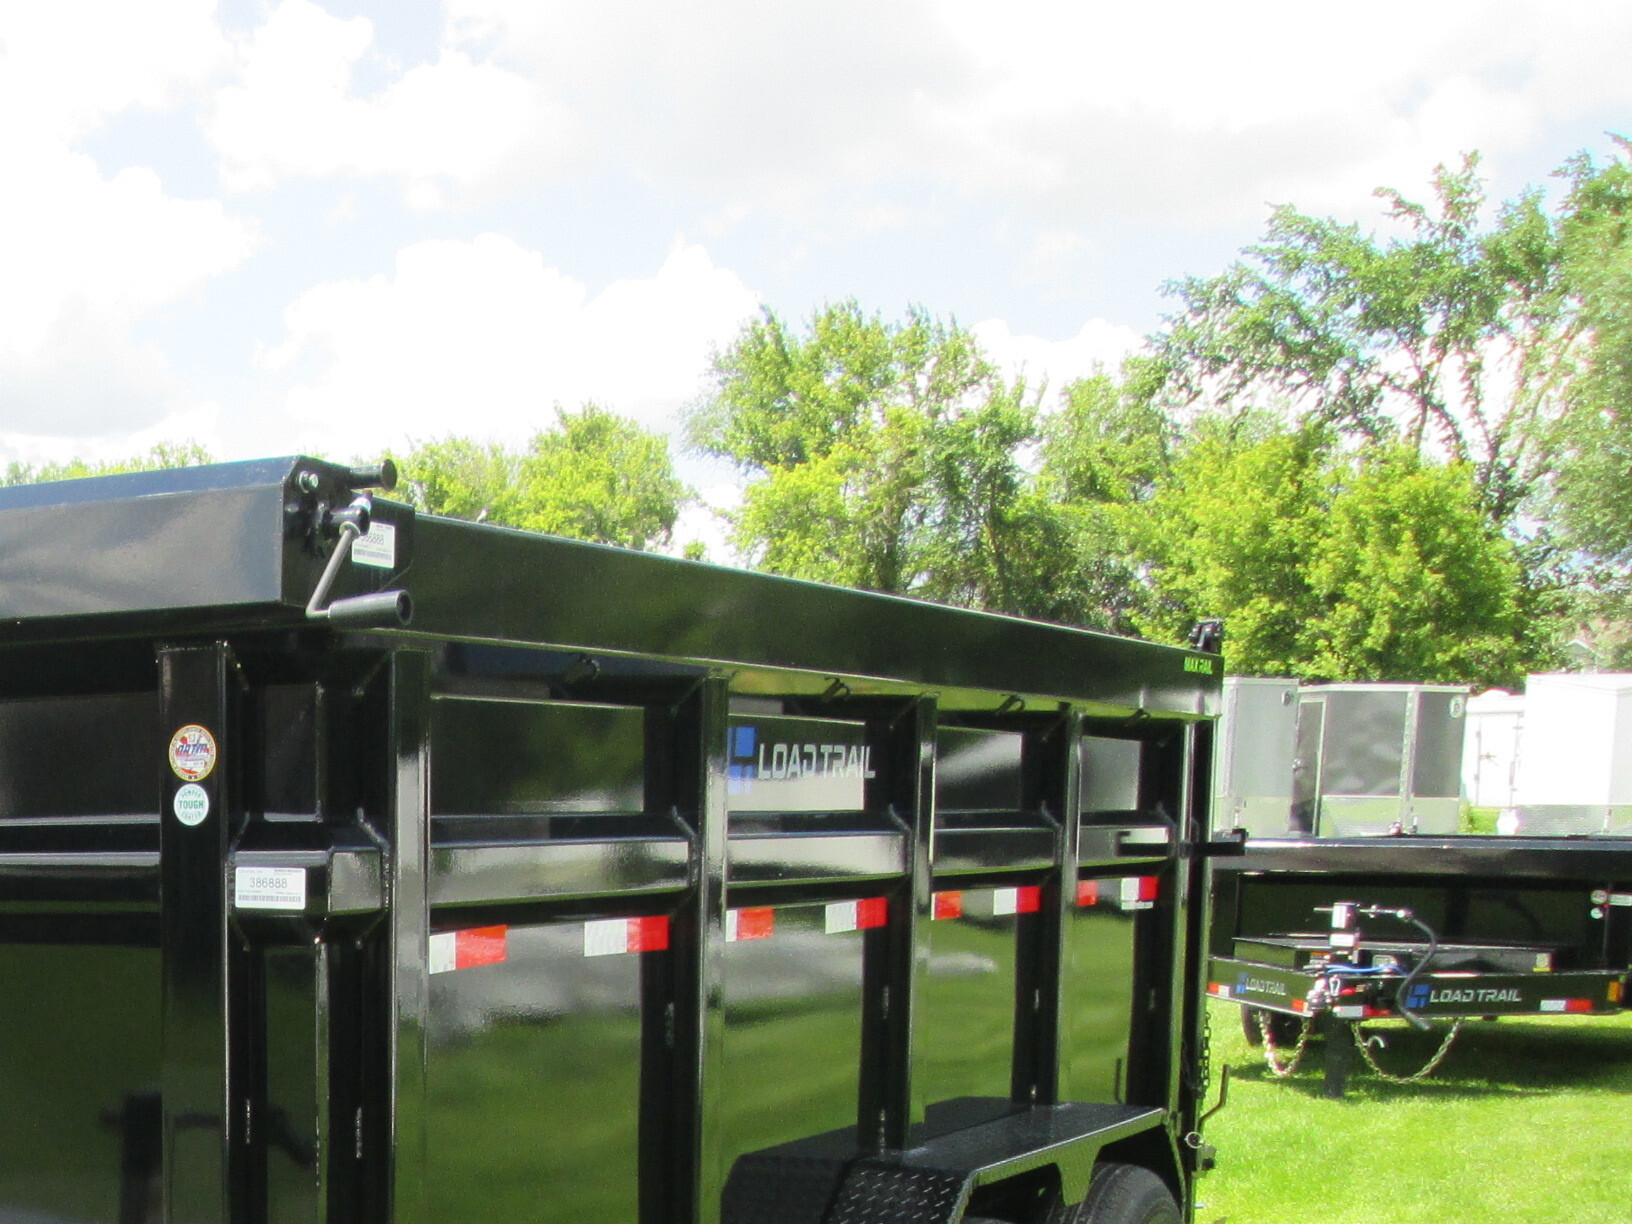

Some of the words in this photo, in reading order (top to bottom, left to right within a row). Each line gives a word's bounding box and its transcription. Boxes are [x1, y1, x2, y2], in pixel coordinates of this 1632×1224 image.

[758, 743, 817, 779] LOAD
[820, 744, 876, 779] TRAIL
[179, 800, 204, 810] TOUGH
[249, 878, 288, 889] 386888
[1429, 989, 1474, 1002] LOAD
[1476, 989, 1522, 1002] TRAIL
